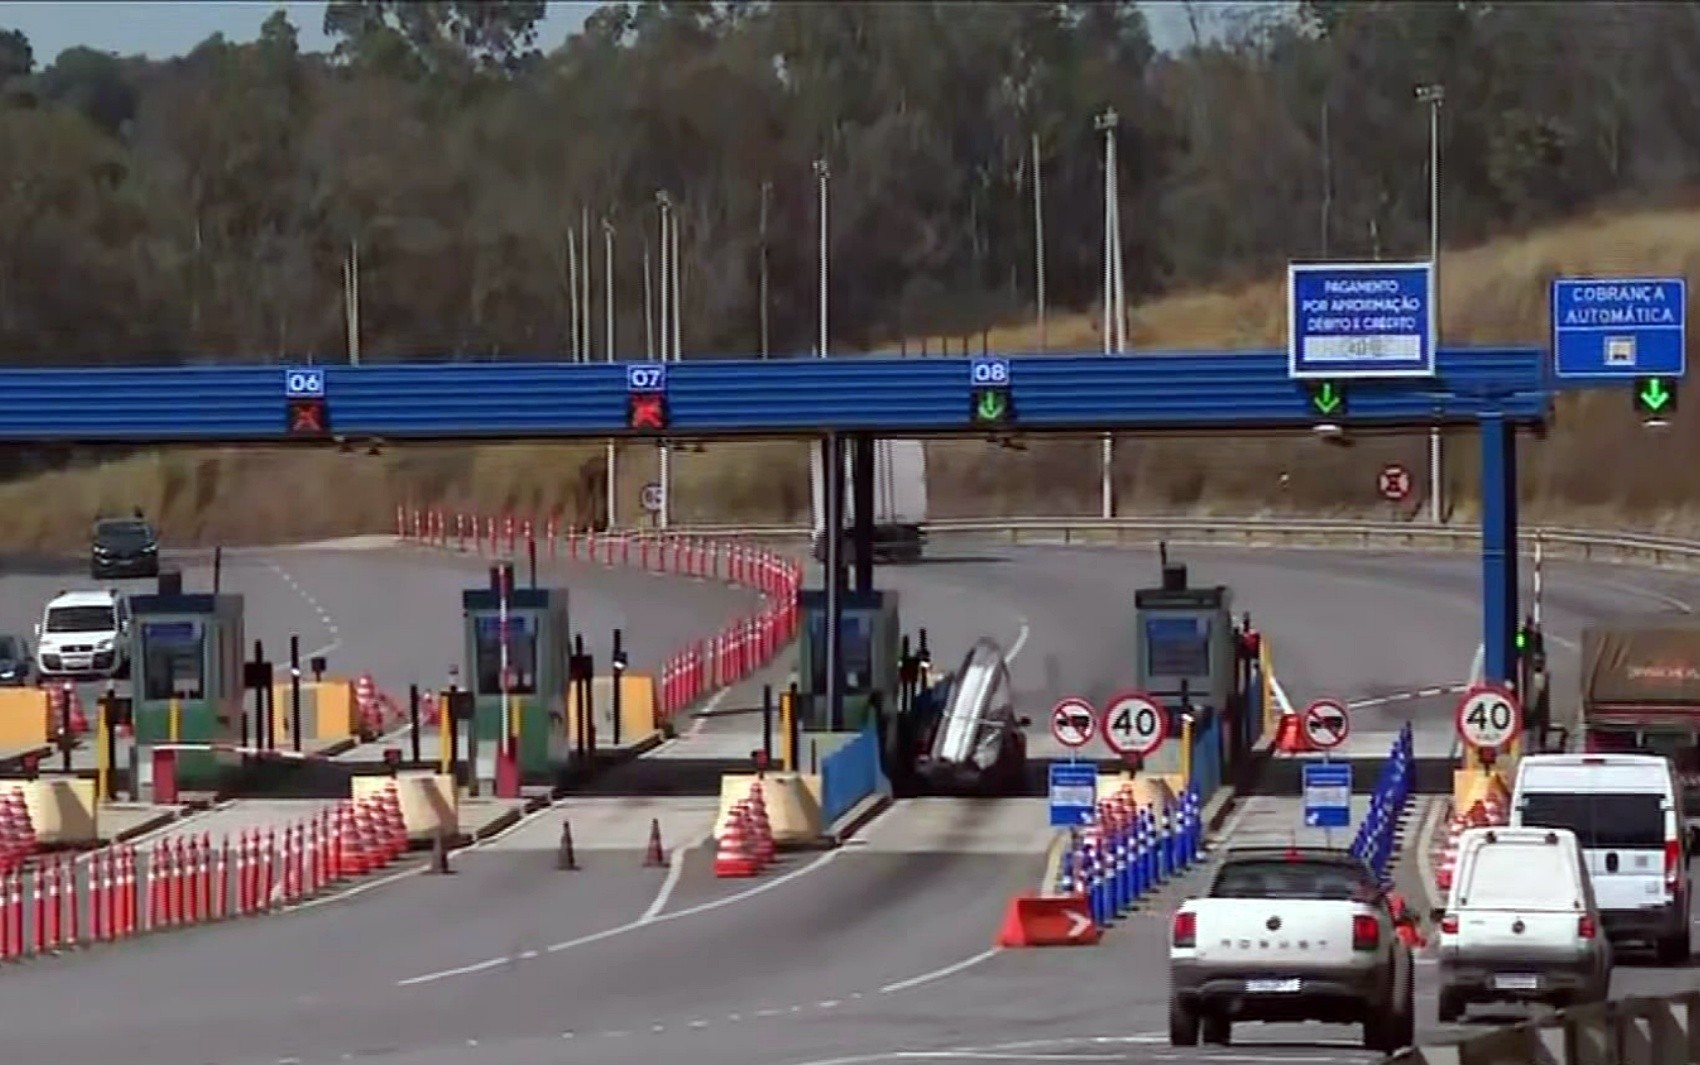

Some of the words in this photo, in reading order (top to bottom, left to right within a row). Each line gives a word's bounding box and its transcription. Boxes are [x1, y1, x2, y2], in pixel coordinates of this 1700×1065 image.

[1572, 286, 1666, 302] COBRANÇA
[1564, 303, 1675, 323] AUTOMÁTICA
[632, 369, 660, 386] 07
[975, 364, 1005, 381] 08
[290, 374, 320, 391] 06
[1112, 708, 1156, 736] 40
[1466, 701, 1511, 730] 40
